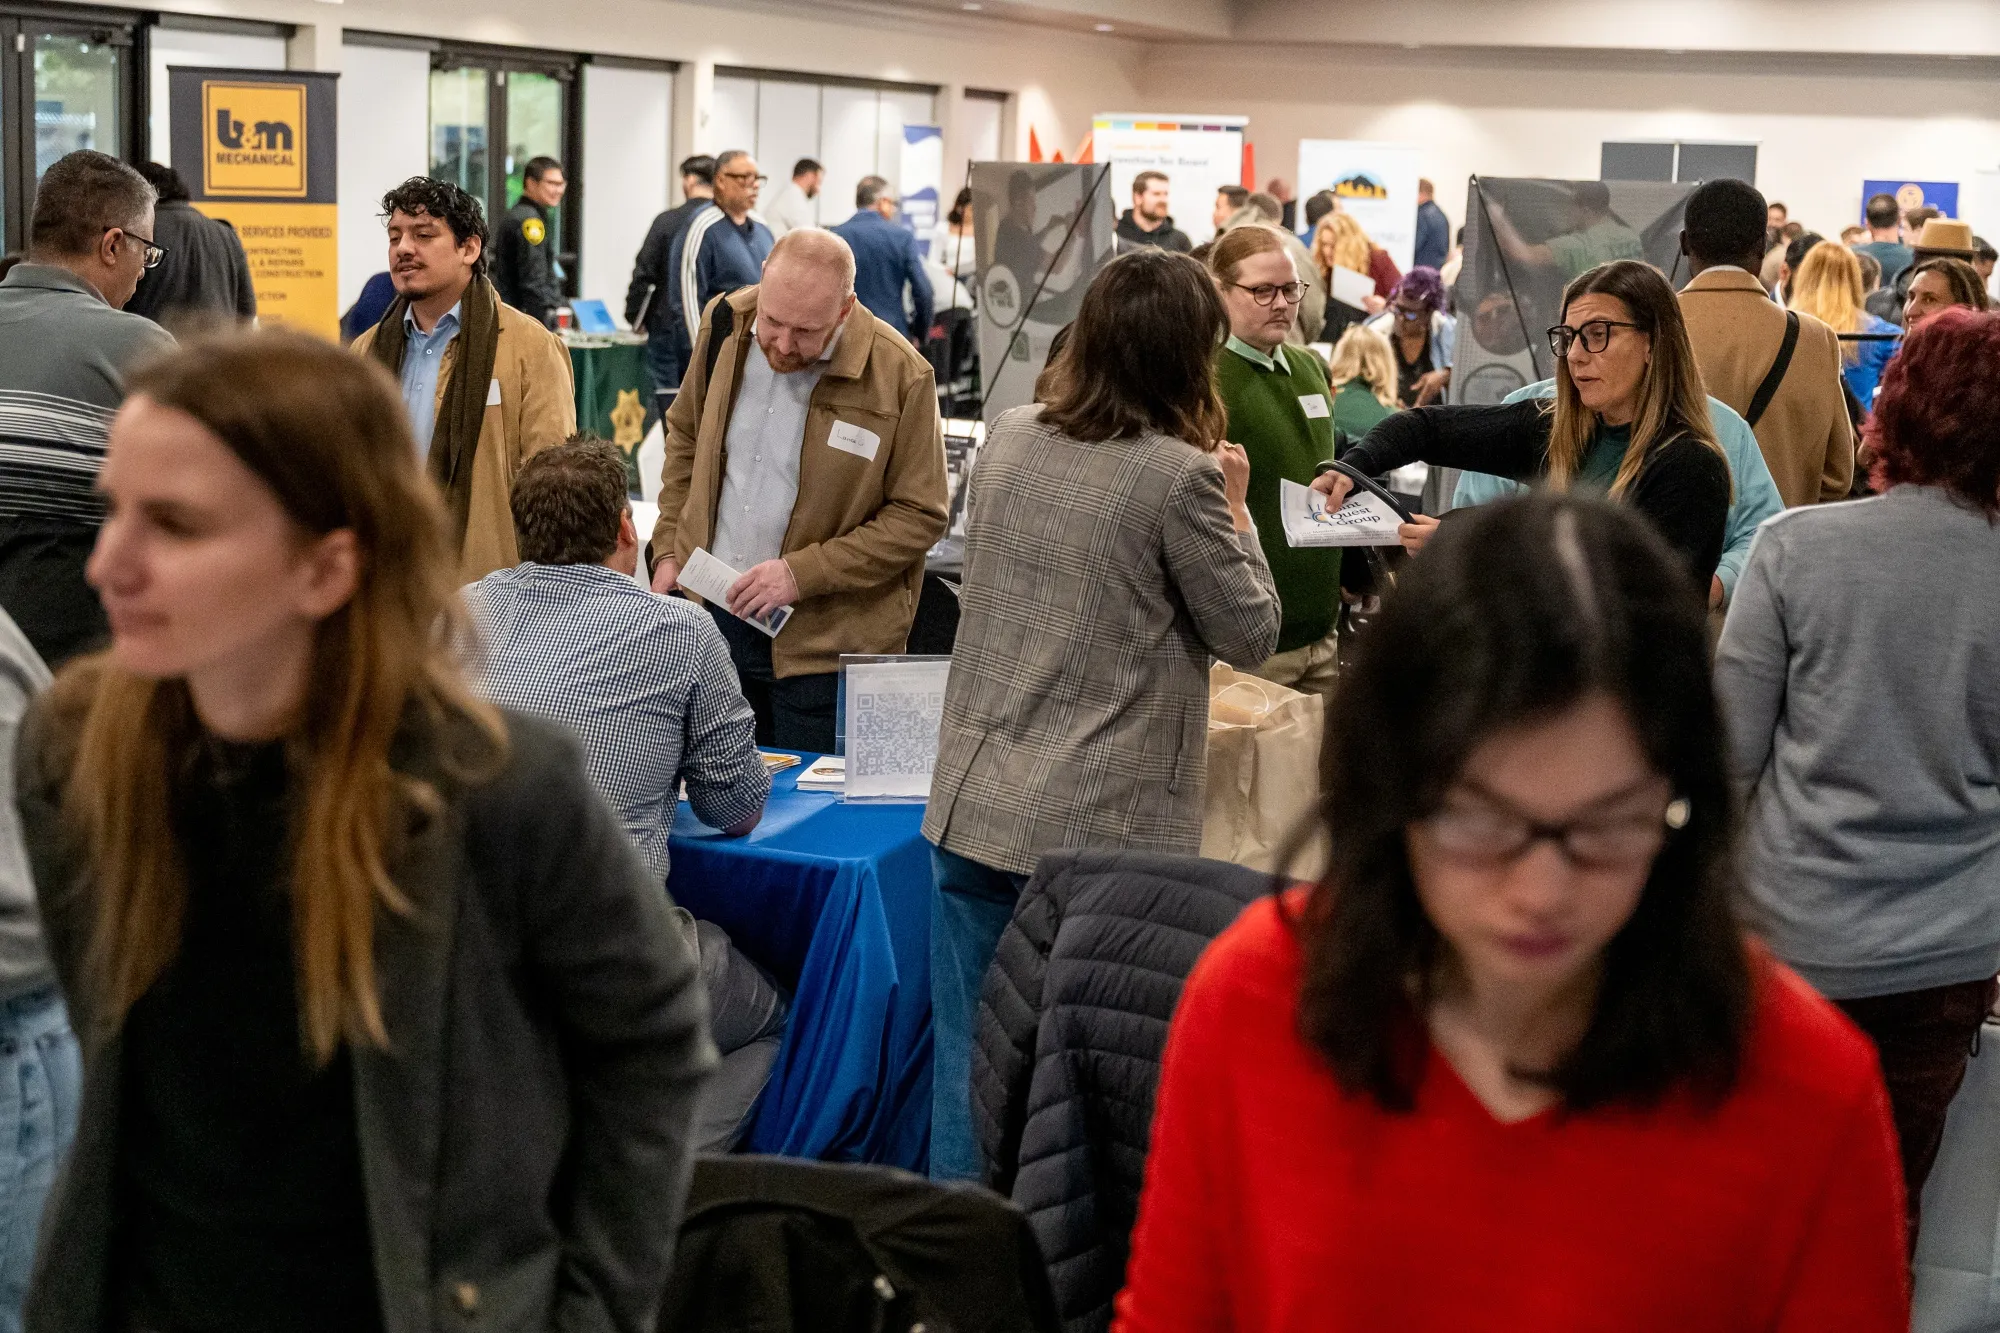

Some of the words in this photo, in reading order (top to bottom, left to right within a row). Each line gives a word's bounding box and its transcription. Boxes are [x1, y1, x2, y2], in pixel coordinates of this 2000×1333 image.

[216, 152, 295, 166] MECHANICAL
[242, 226, 285, 239] SERVICES
[287, 226, 333, 239] PROVIDED
[244, 247, 303, 256] ONTRACTING
[1330, 507, 1372, 520] Quest
[1336, 515, 1381, 526] Group
